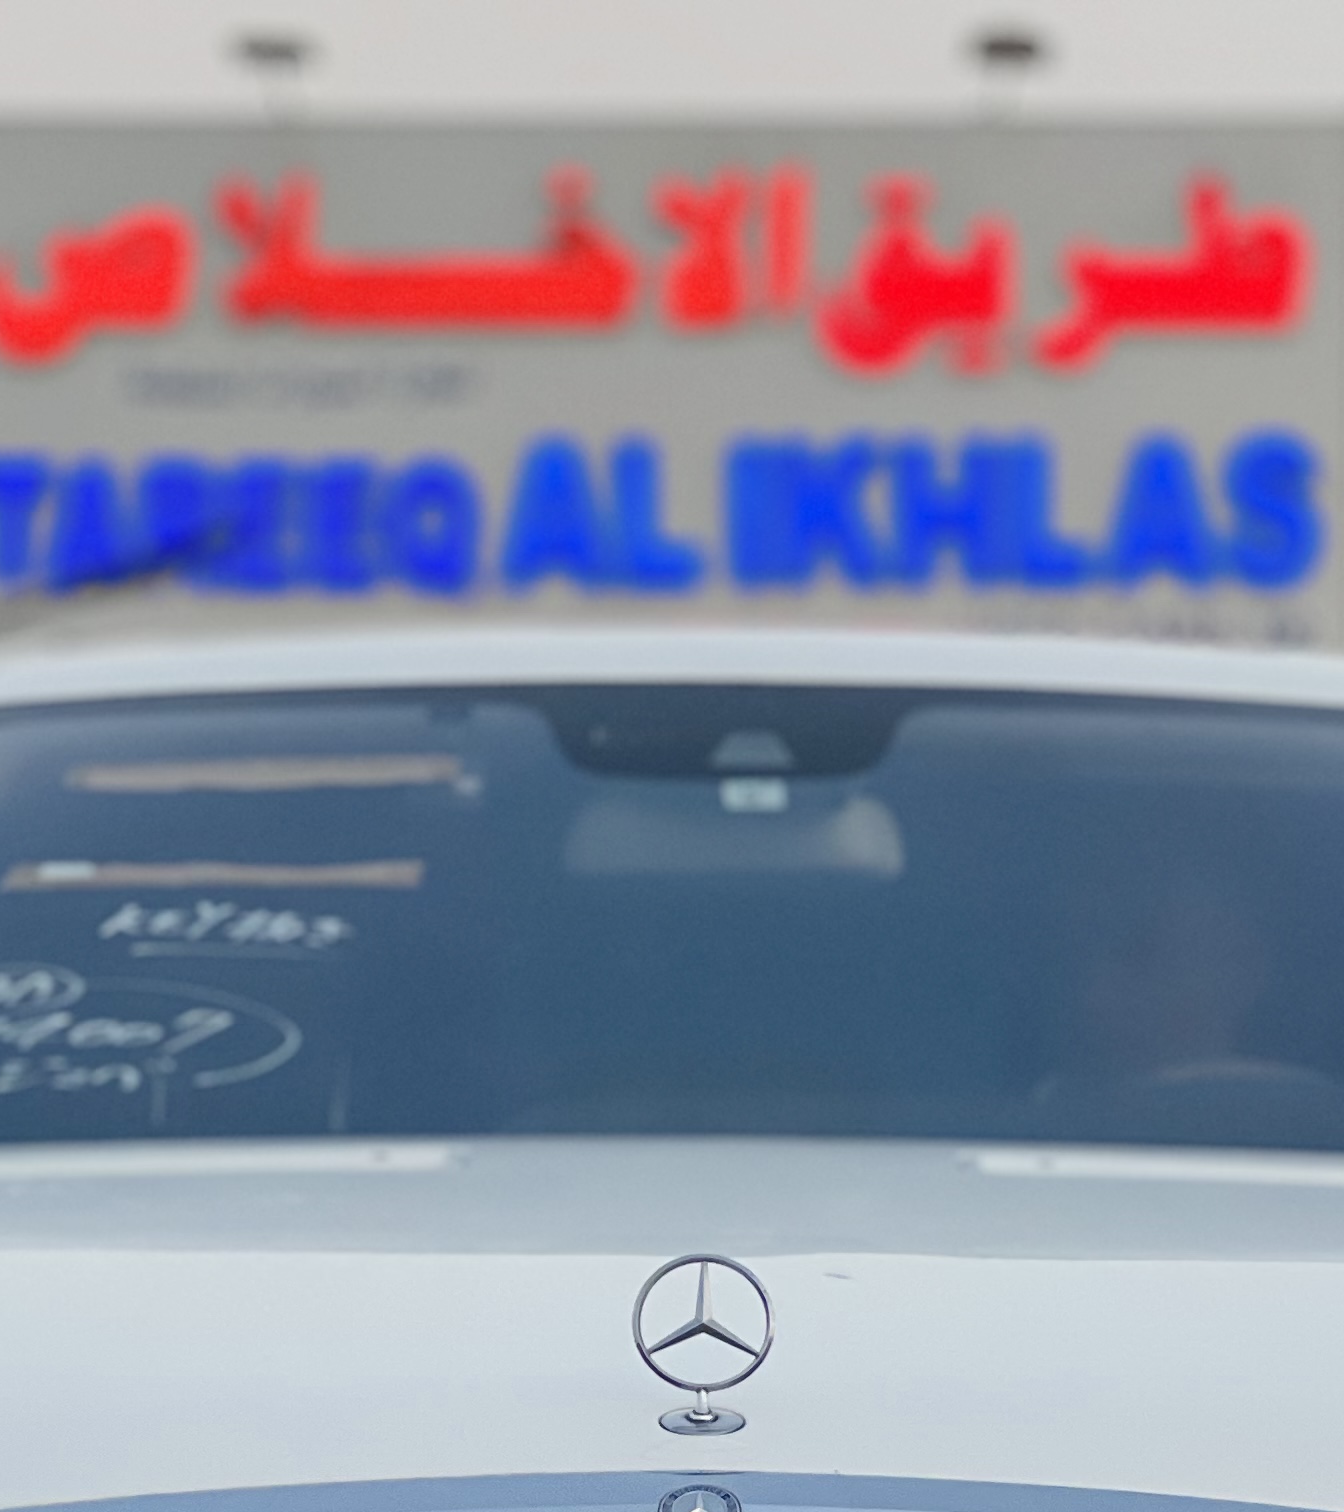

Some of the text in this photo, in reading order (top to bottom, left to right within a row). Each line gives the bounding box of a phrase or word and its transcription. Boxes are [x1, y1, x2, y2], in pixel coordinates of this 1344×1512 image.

[814, 166, 1314, 376] طريق
[498, 426, 704, 597] AL
[721, 426, 1328, 599] IKHLAS
